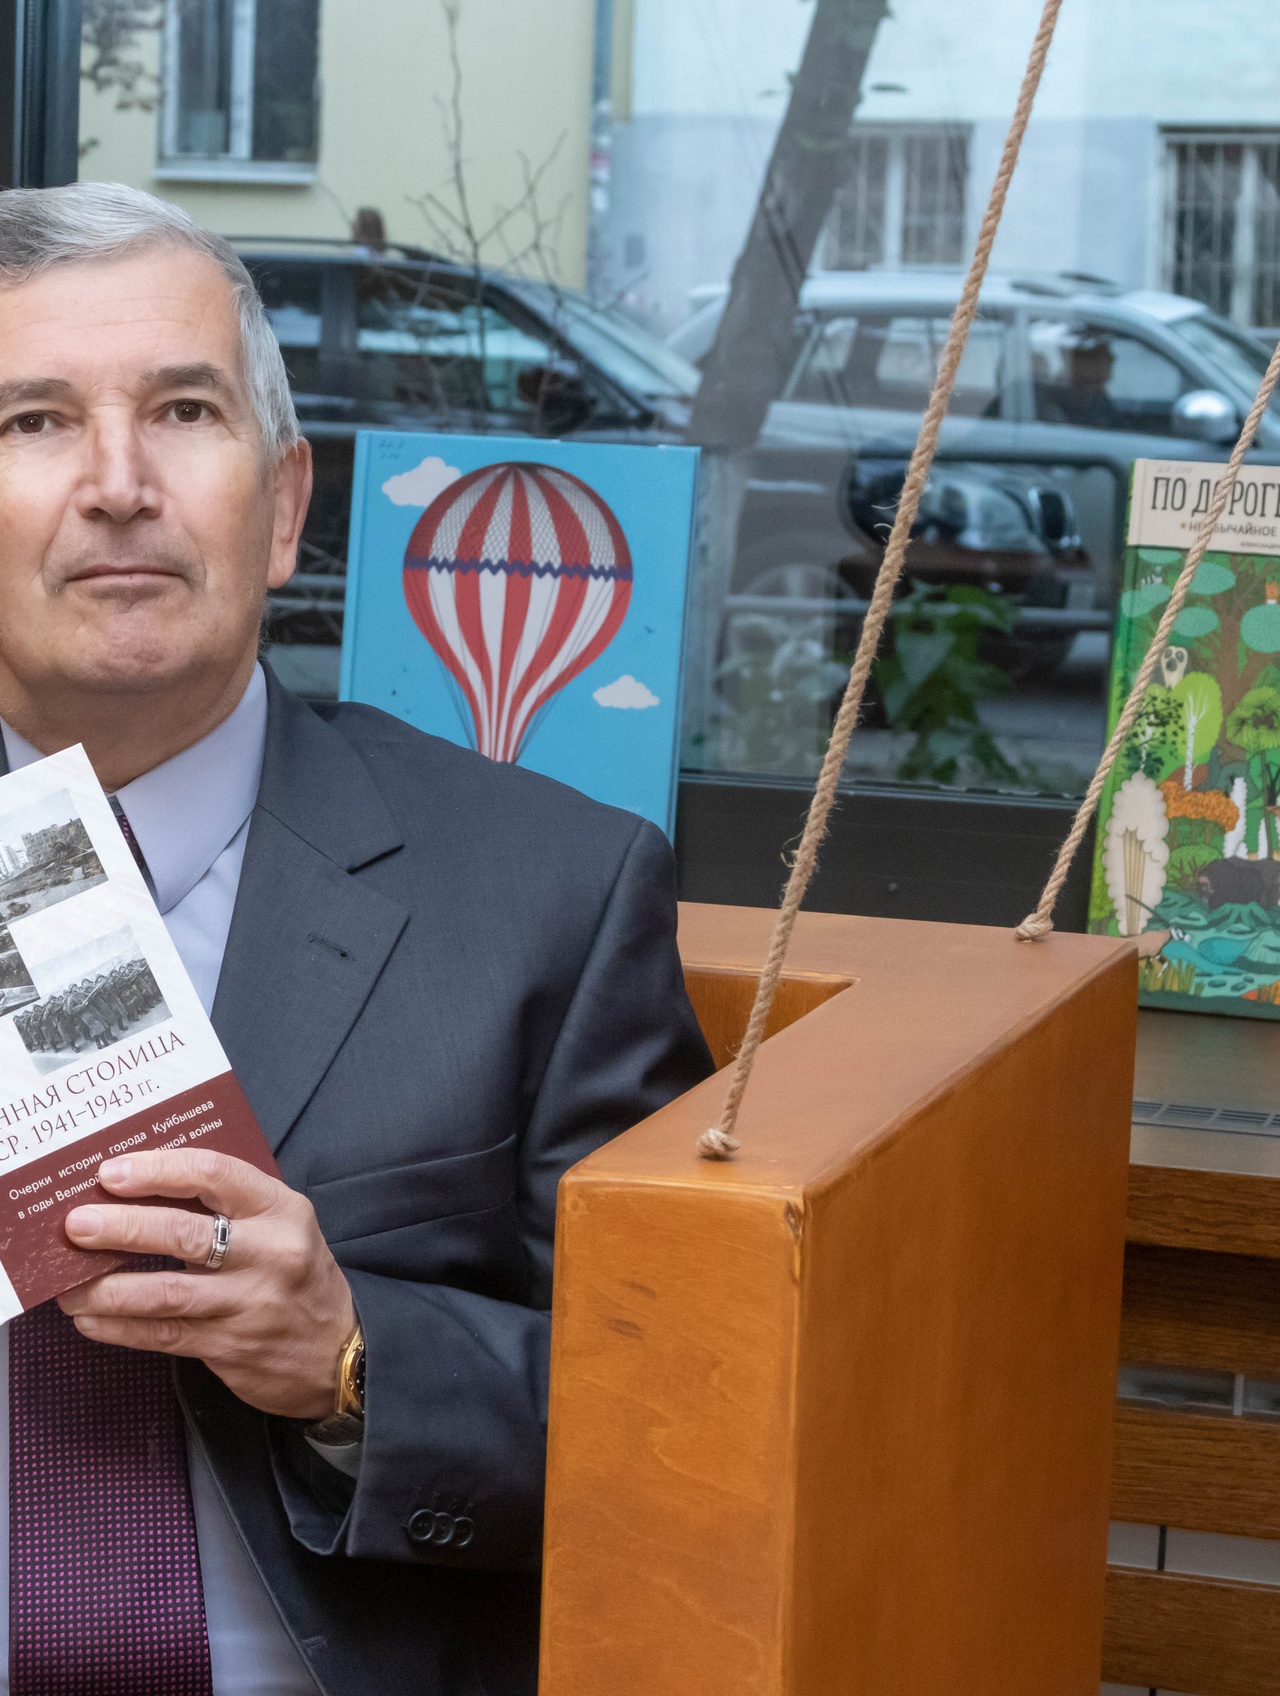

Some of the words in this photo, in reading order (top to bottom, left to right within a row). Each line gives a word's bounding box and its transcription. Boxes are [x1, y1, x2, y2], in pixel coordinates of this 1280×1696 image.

[1151, 476, 1187, 511] ПО
[66, 1030, 186, 1095] СТОЛИЦА
[137, 1079, 160, 1097] гг.
[8, 1176, 53, 1201] Очерки
[57, 1152, 104, 1179] истории
[108, 1132, 148, 1156] города
[151, 1099, 215, 1135] Куйбышева
[17, 1210, 25, 1219] в
[27, 1198, 55, 1217] годы
[189, 1118, 223, 1140] войны
